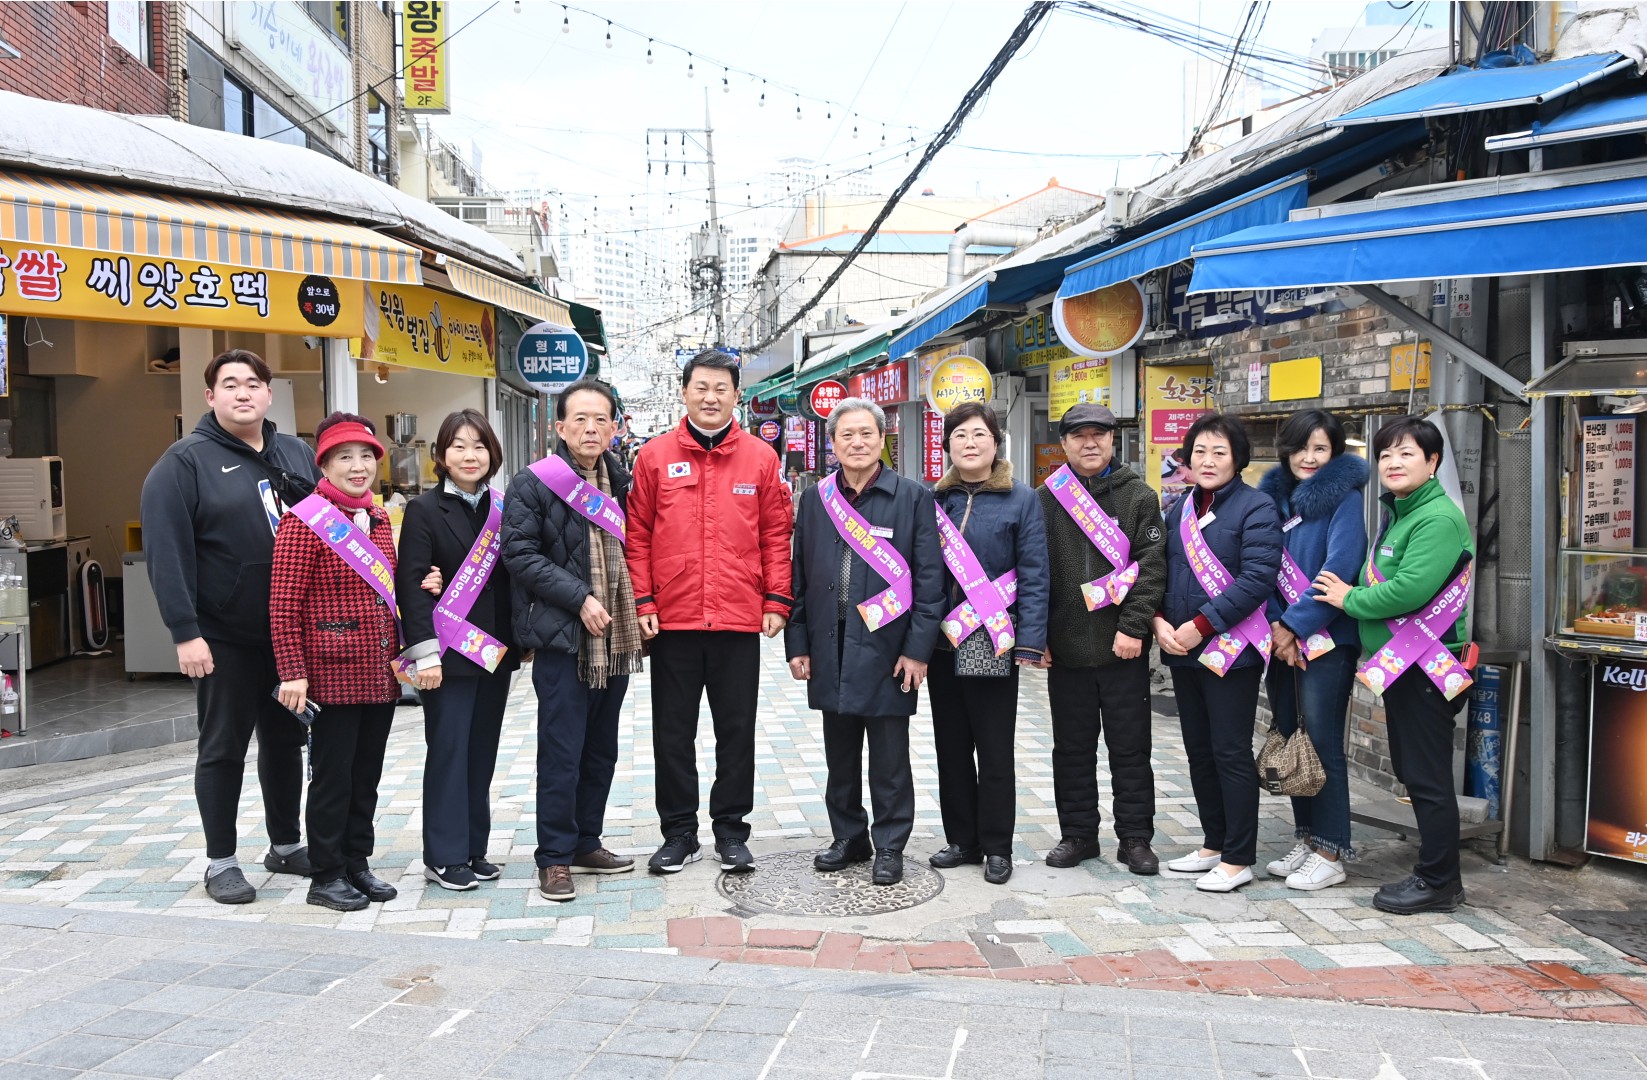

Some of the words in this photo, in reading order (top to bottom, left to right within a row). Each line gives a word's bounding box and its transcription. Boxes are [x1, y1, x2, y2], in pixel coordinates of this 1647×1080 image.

[407, 0, 442, 92] 왕족발
[417, 95, 432, 106] 2F
[0, 250, 67, 302] 쌀
[86, 255, 270, 318] 씨앗호떡
[306, 285, 331, 297] 앞으로
[315, 304, 336, 317] 30년
[406, 316, 430, 354] 벌집
[523, 356, 580, 374] 돼지국밥
[817, 387, 840, 397] 유명한
[878, 367, 901, 400] 산곰장어
[936, 386, 986, 406] 씨앗호떡
